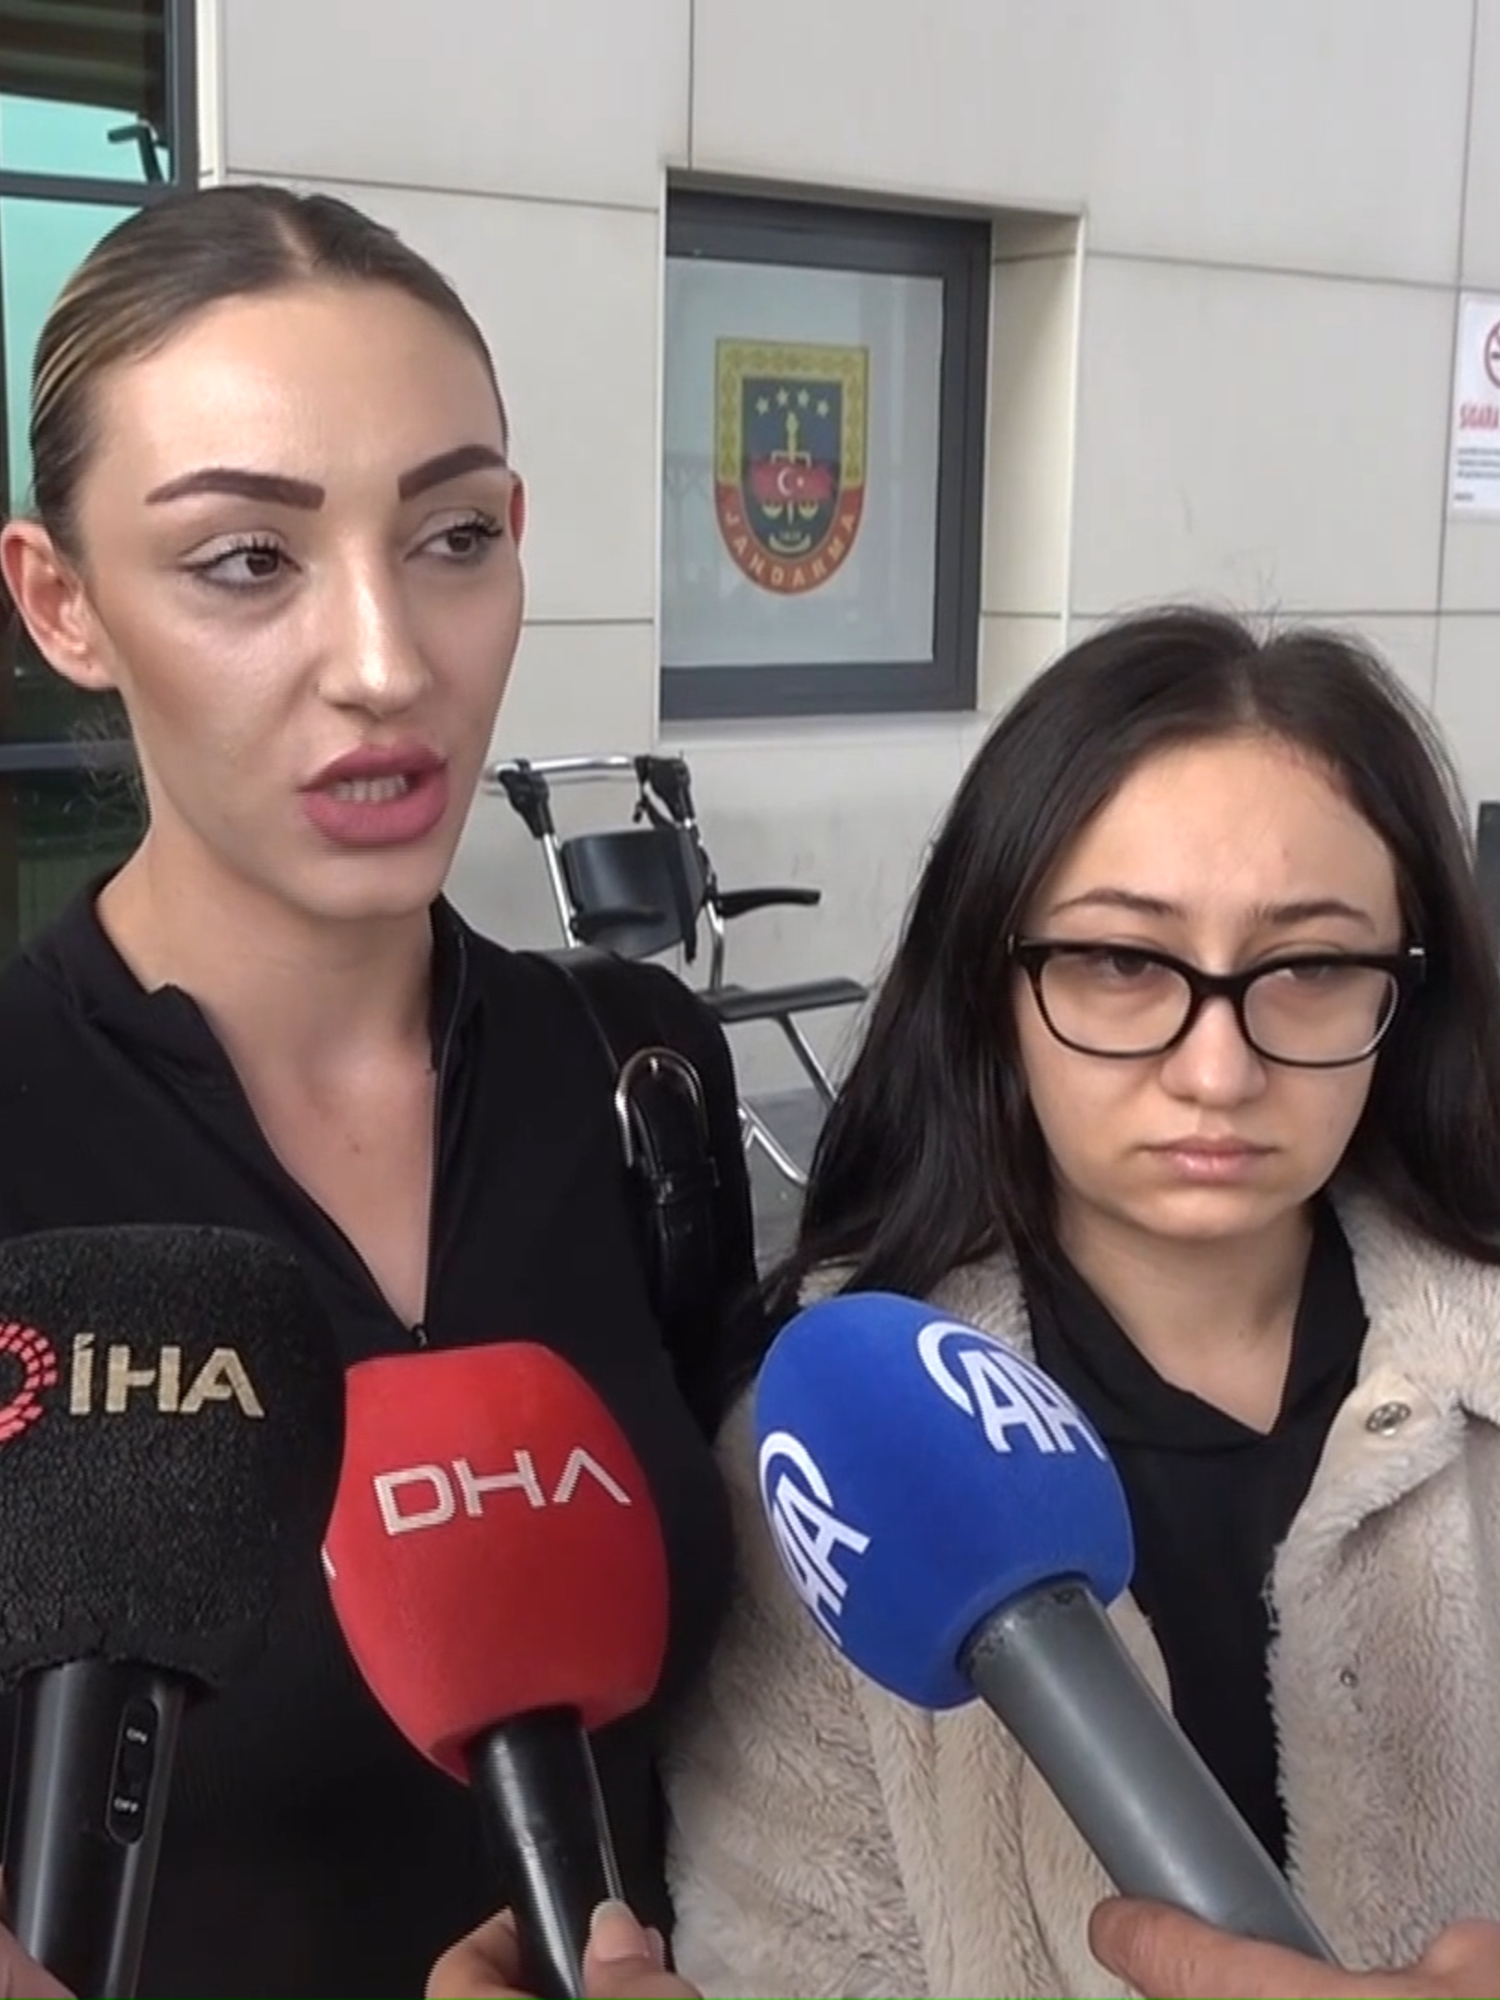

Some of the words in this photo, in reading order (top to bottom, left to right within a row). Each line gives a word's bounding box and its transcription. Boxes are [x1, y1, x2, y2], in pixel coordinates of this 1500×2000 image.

[725, 512, 855, 588] JANDARMA
[69, 1332, 266, 1419] İHA
[373, 1446, 632, 1536] DHA
